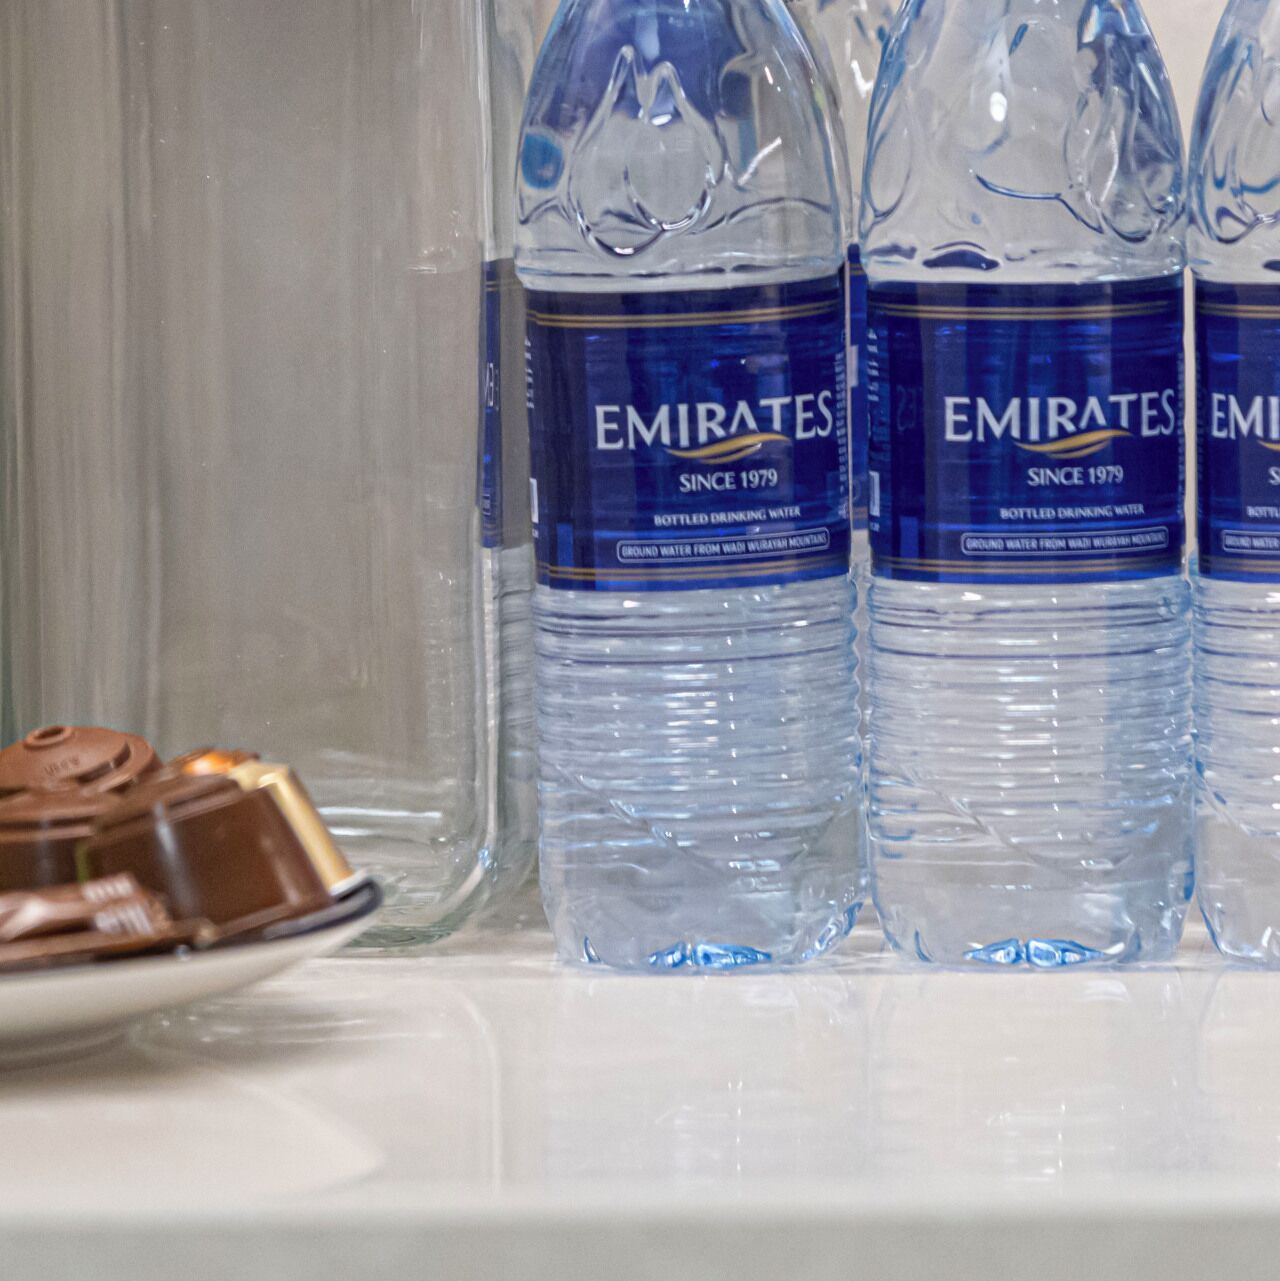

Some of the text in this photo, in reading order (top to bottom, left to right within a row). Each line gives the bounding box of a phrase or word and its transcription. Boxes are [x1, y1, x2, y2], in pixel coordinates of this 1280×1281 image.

[595, 389, 834, 451] EMIRATES
[944, 388, 1175, 443] EMIRATES
[679, 468, 778, 493] SINCE 1979
[1026, 465, 1124, 487] SINCE 1979
[653, 505, 801, 527] BOTTLED DRINKING WATER
[999, 503, 1145, 520] BOTTLED DRINKING WATER
[621, 544, 658, 558] GROUND
[659, 544, 692, 557] WATER
[693, 543, 720, 555] FROM
[721, 541, 746, 554] WADI
[1005, 538, 1038, 551] WATER
[1039, 538, 1066, 550] FROM
